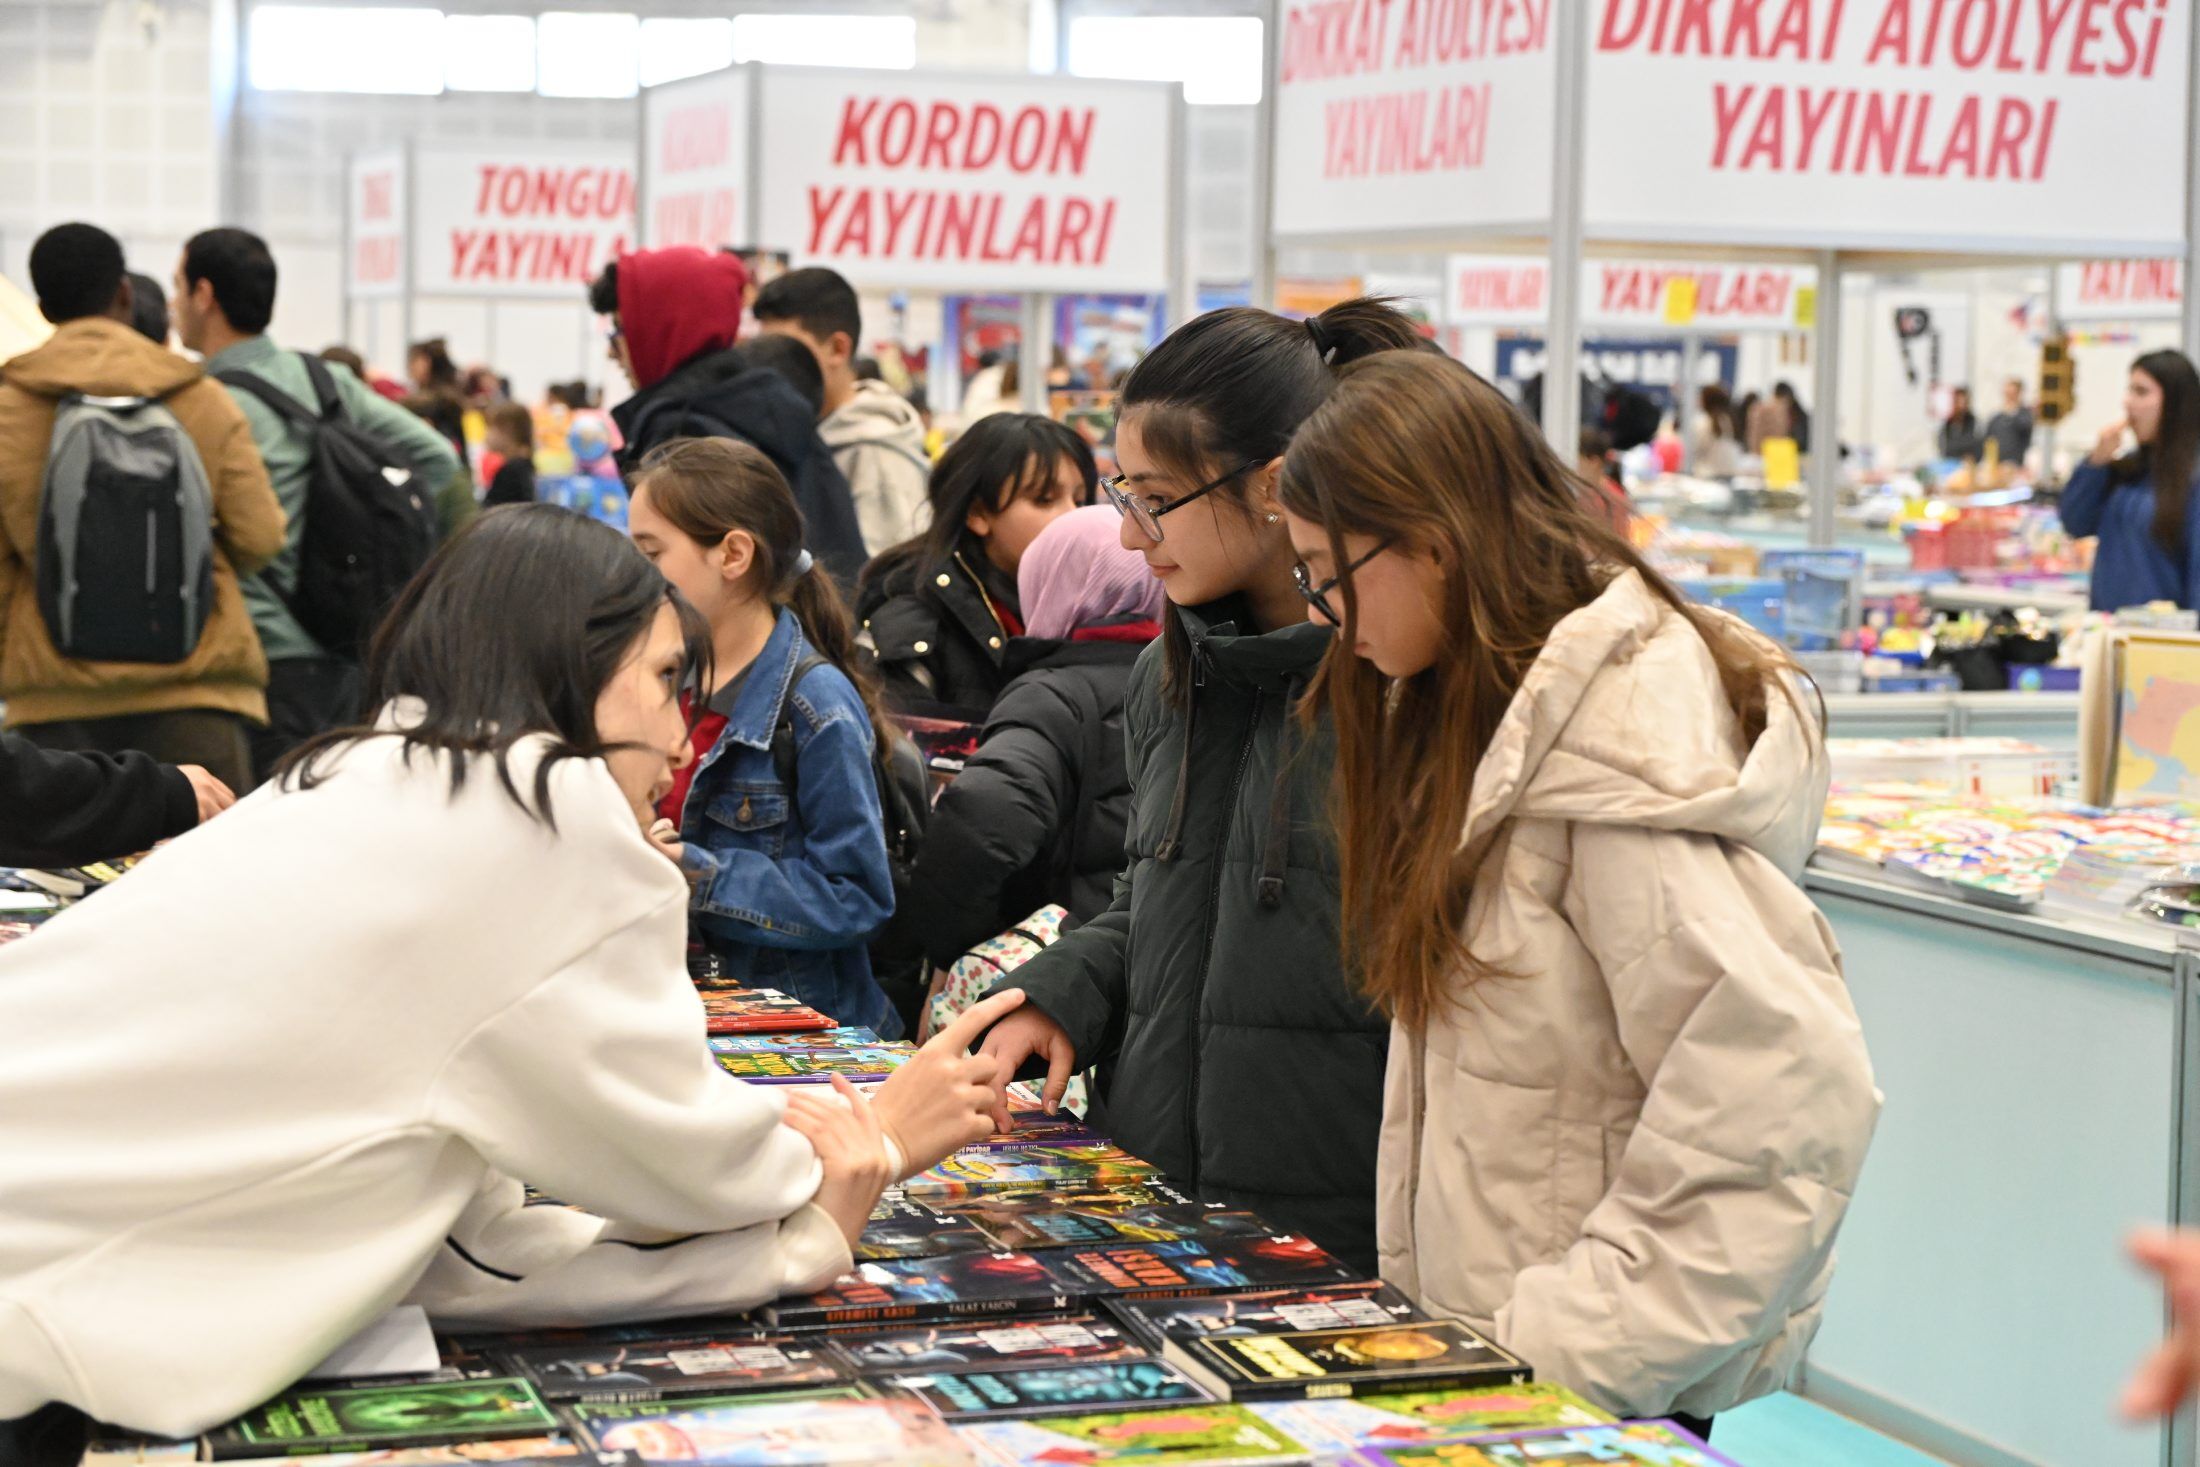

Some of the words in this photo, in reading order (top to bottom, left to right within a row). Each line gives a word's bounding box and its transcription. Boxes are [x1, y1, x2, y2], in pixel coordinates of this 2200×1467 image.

[832, 97, 1095, 177] KORDON
[1323, 82, 1491, 181] YAYINLARI
[1710, 83, 2058, 182] YAYINLARI
[807, 186, 1117, 265] YAYINLARI
